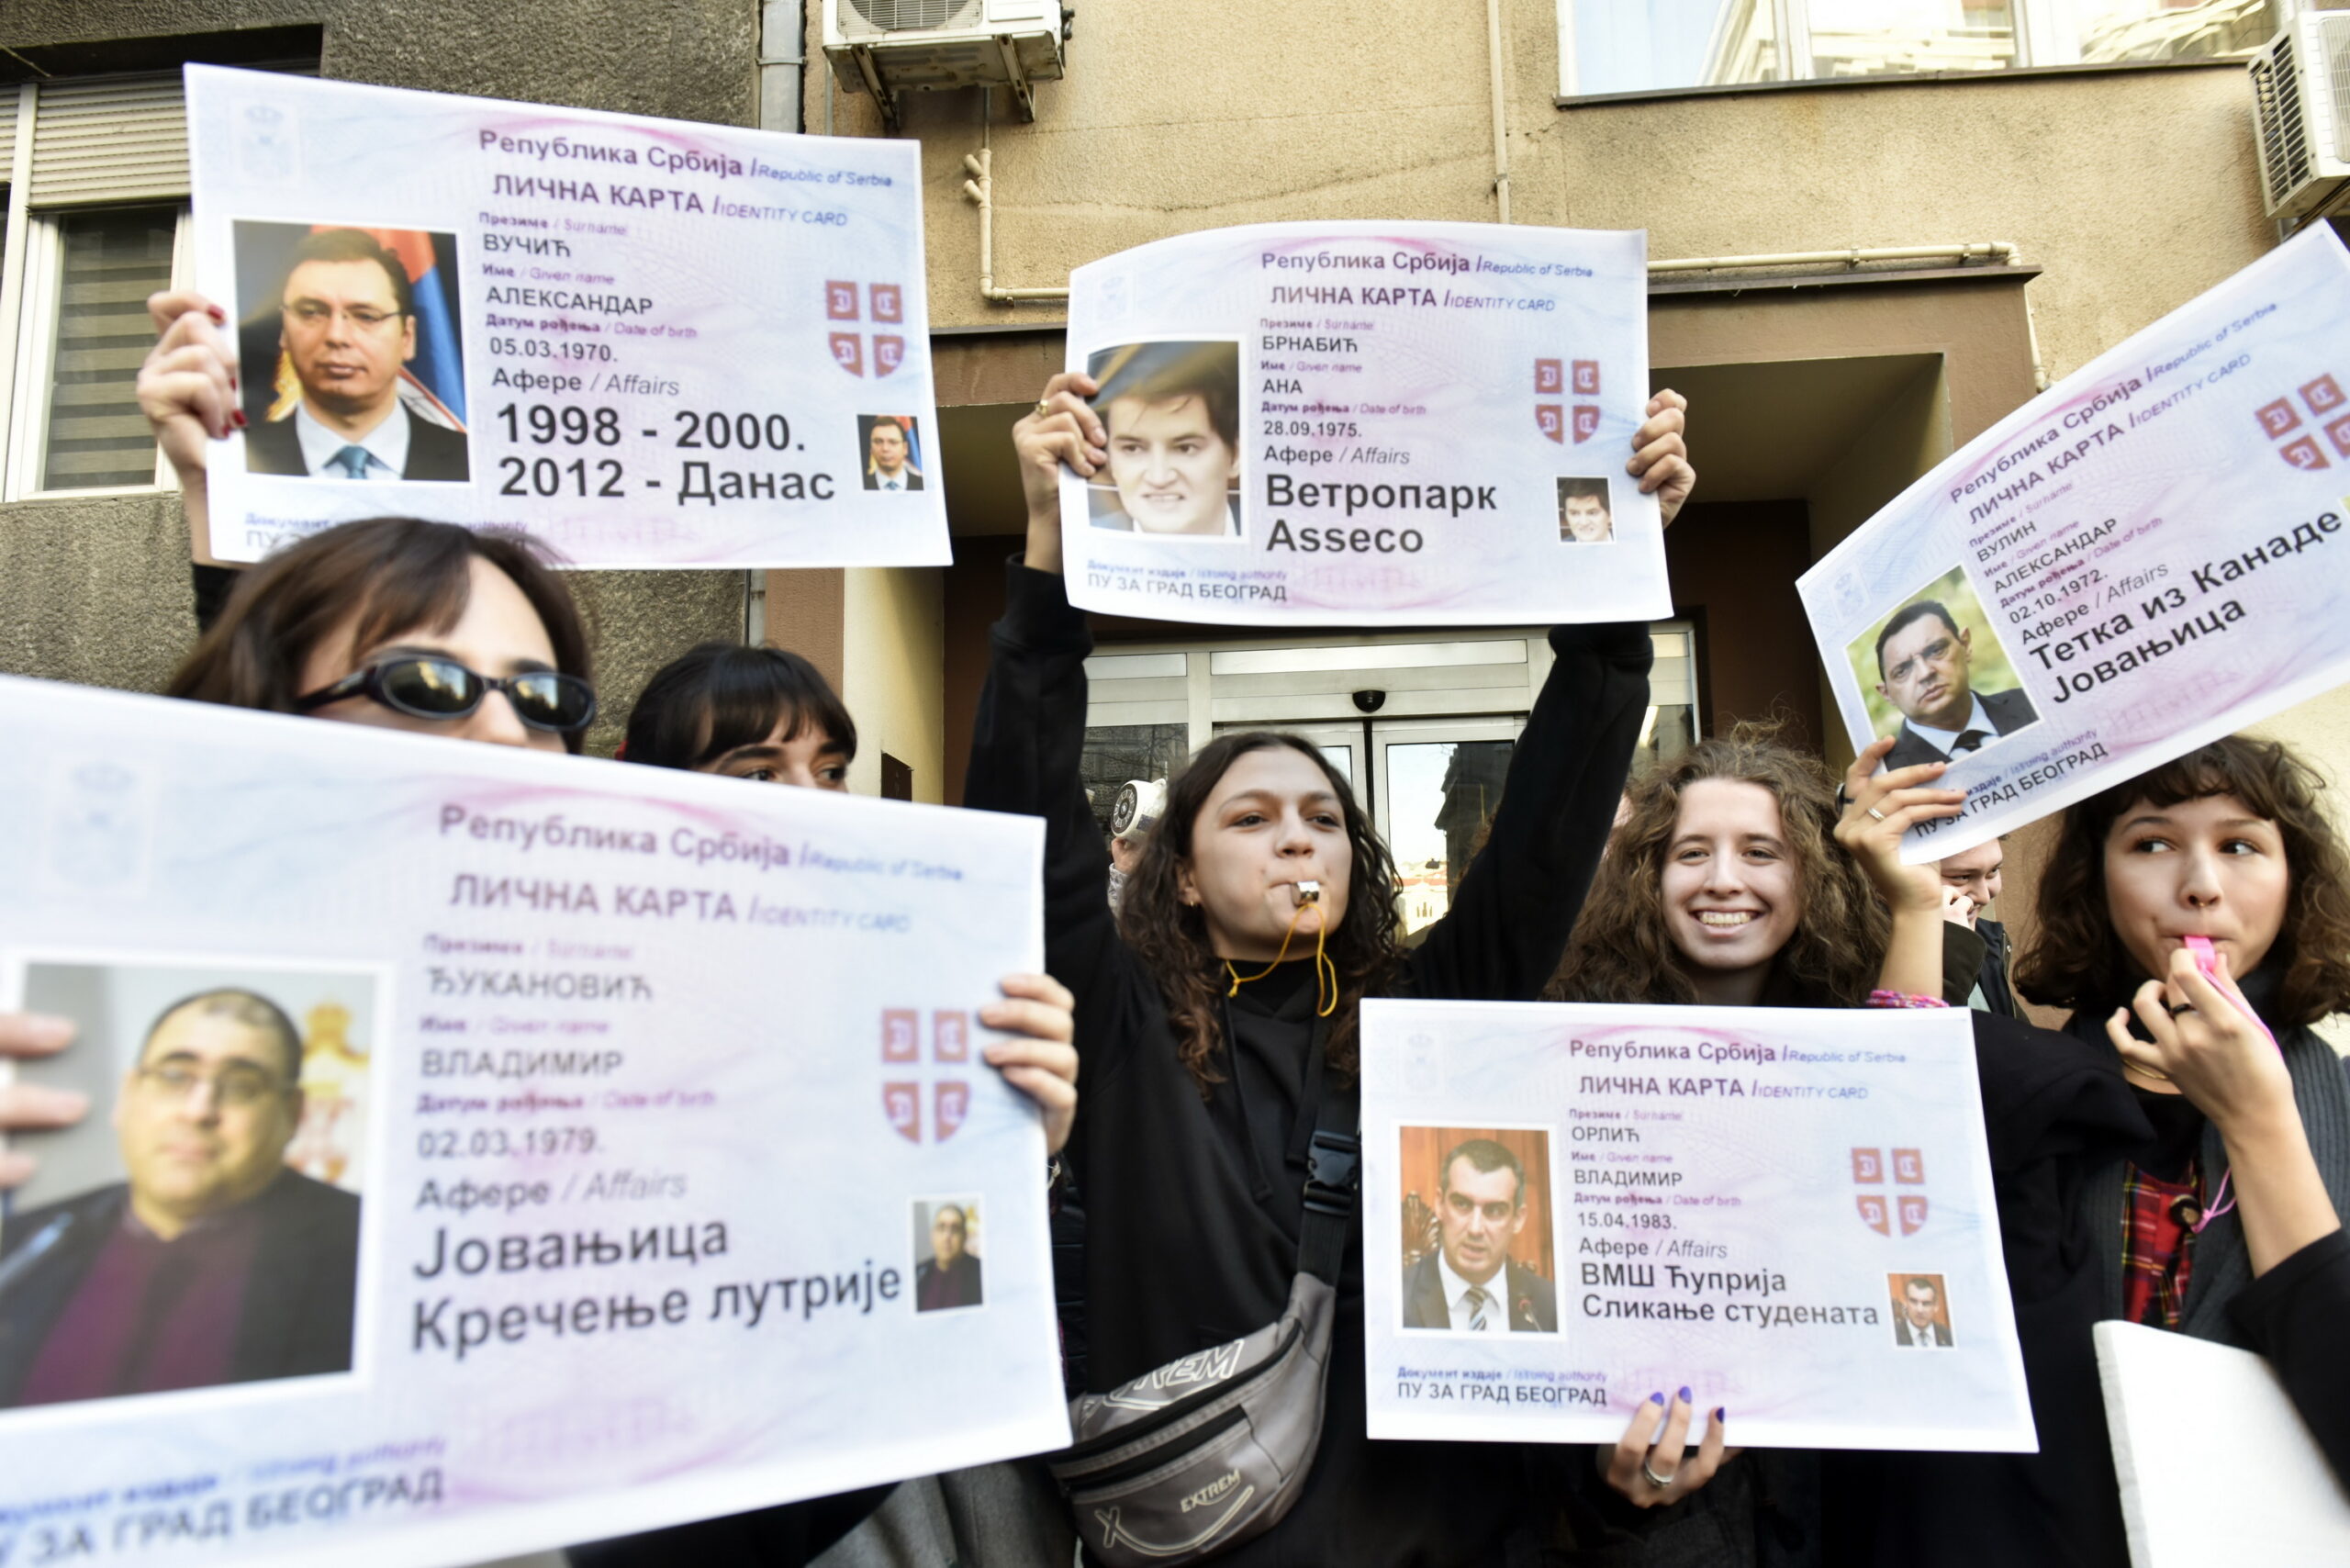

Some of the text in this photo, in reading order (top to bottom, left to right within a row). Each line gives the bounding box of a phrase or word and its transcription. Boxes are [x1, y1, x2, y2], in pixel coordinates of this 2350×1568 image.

[479, 129, 637, 165] Република
[647, 147, 743, 179] Србија
[845, 172, 892, 187] Serbia
[493, 174, 599, 204] ЛИЧНА
[610, 185, 704, 214] КАРТА
[802, 209, 847, 227] CARD
[479, 211, 548, 230] Презиме
[483, 233, 571, 257] ВУЧИЋ
[482, 263, 614, 285] Име Given name
[1261, 252, 1385, 274] Република
[1393, 252, 1470, 276] Србија
[1555, 264, 1593, 277] Serbia
[487, 286, 653, 316] АЛЕКСАНДАР
[1271, 286, 1353, 306] ЛИЧНА
[1361, 287, 1437, 307] КАРТА
[1517, 298, 1555, 312] CARD
[487, 313, 697, 339] Датум рођења Date of birth
[1260, 319, 1313, 330] Презиме
[489, 336, 618, 363] 05.03.1970.
[1262, 335, 1358, 353] БРНАБИЋ
[492, 368, 680, 397] Афере Affairs
[1260, 361, 1361, 373] Име Given name
[1262, 378, 1304, 395] АНА
[1261, 401, 1427, 416] Датум рођења Date of birth
[1950, 426, 2059, 504] Република
[2063, 376, 2143, 430] Србија
[2232, 302, 2277, 332] Serbia
[497, 403, 805, 452] 1998 - 2000.
[1263, 420, 1361, 438] 28.09.1975.
[1968, 469, 2045, 525] ЛИЧНА
[2047, 422, 2125, 476] КАРТА
[2208, 353, 2252, 385] CARD
[1264, 445, 1410, 466] Афере Affairs
[498, 456, 834, 506] 2012 - Данас
[1266, 474, 1497, 518] Ветропарк
[1266, 520, 1423, 554] Asseco
[1969, 514, 2017, 548] Презиме
[1976, 521, 2038, 563] ВУЛИН
[1984, 519, 2079, 578] Име Given name
[1994, 518, 2118, 595] АЛЕКСАНДАР
[1999, 516, 2164, 609] Датум рођења Date of birth
[1088, 574, 1287, 601] ПУ ЗА ГРАД БЕОГРАД
[2009, 569, 2109, 625] 02.10.1972.
[2029, 510, 2342, 671] Тетка из Канаде
[2020, 563, 2169, 646] Афере Affairs
[2052, 597, 2247, 705] Јовањица
[2051, 728, 2098, 755] authority
[1970, 783, 2019, 813] ГРАД
[2020, 742, 2109, 792] БЕОГРАД
[439, 804, 657, 856] Република
[670, 826, 789, 869] Србија
[449, 872, 599, 915] ЛИЧНА
[613, 883, 736, 923] КАРТА
[425, 965, 653, 1001] ЂУКАНОВИЋ
[420, 1049, 623, 1080] ВЛАДИМИР
[1571, 1039, 1690, 1063] Република
[1698, 1042, 1775, 1066] Србија
[1864, 1051, 1906, 1063] Serbia
[1579, 1076, 1661, 1096] ЛИЧНА
[1669, 1078, 1744, 1097] КАРТА
[1828, 1086, 1868, 1099] CARD
[1569, 1108, 1621, 1121] Презиме
[417, 1126, 604, 1159] 02.03.1979.
[1572, 1126, 1639, 1143] ОРЛИЋ
[1572, 1152, 1673, 1163] Име Given name
[416, 1169, 688, 1214] Афере Affairs
[1574, 1170, 1683, 1188] ВЛАДИМИР
[1574, 1193, 1741, 1206] Датум рођења Date of birth
[1578, 1212, 1677, 1229] 15.04.1983.
[413, 1219, 729, 1281] Јовањица
[1579, 1238, 1727, 1259] Афере Affairs
[1581, 1262, 1786, 1296] ВМШ Ћуприја
[411, 1260, 901, 1361] Кречење лутрије
[1583, 1294, 1878, 1328] Сликање студената
[1397, 1366, 1459, 1380] Документ
[1398, 1383, 1607, 1406] ПУ ЗА ГРАД БЕОГРАД
[1181, 1468, 1242, 1513] EXTREM
[113, 1499, 232, 1551] ГРАД
[245, 1468, 444, 1529] БЕОГРАД
